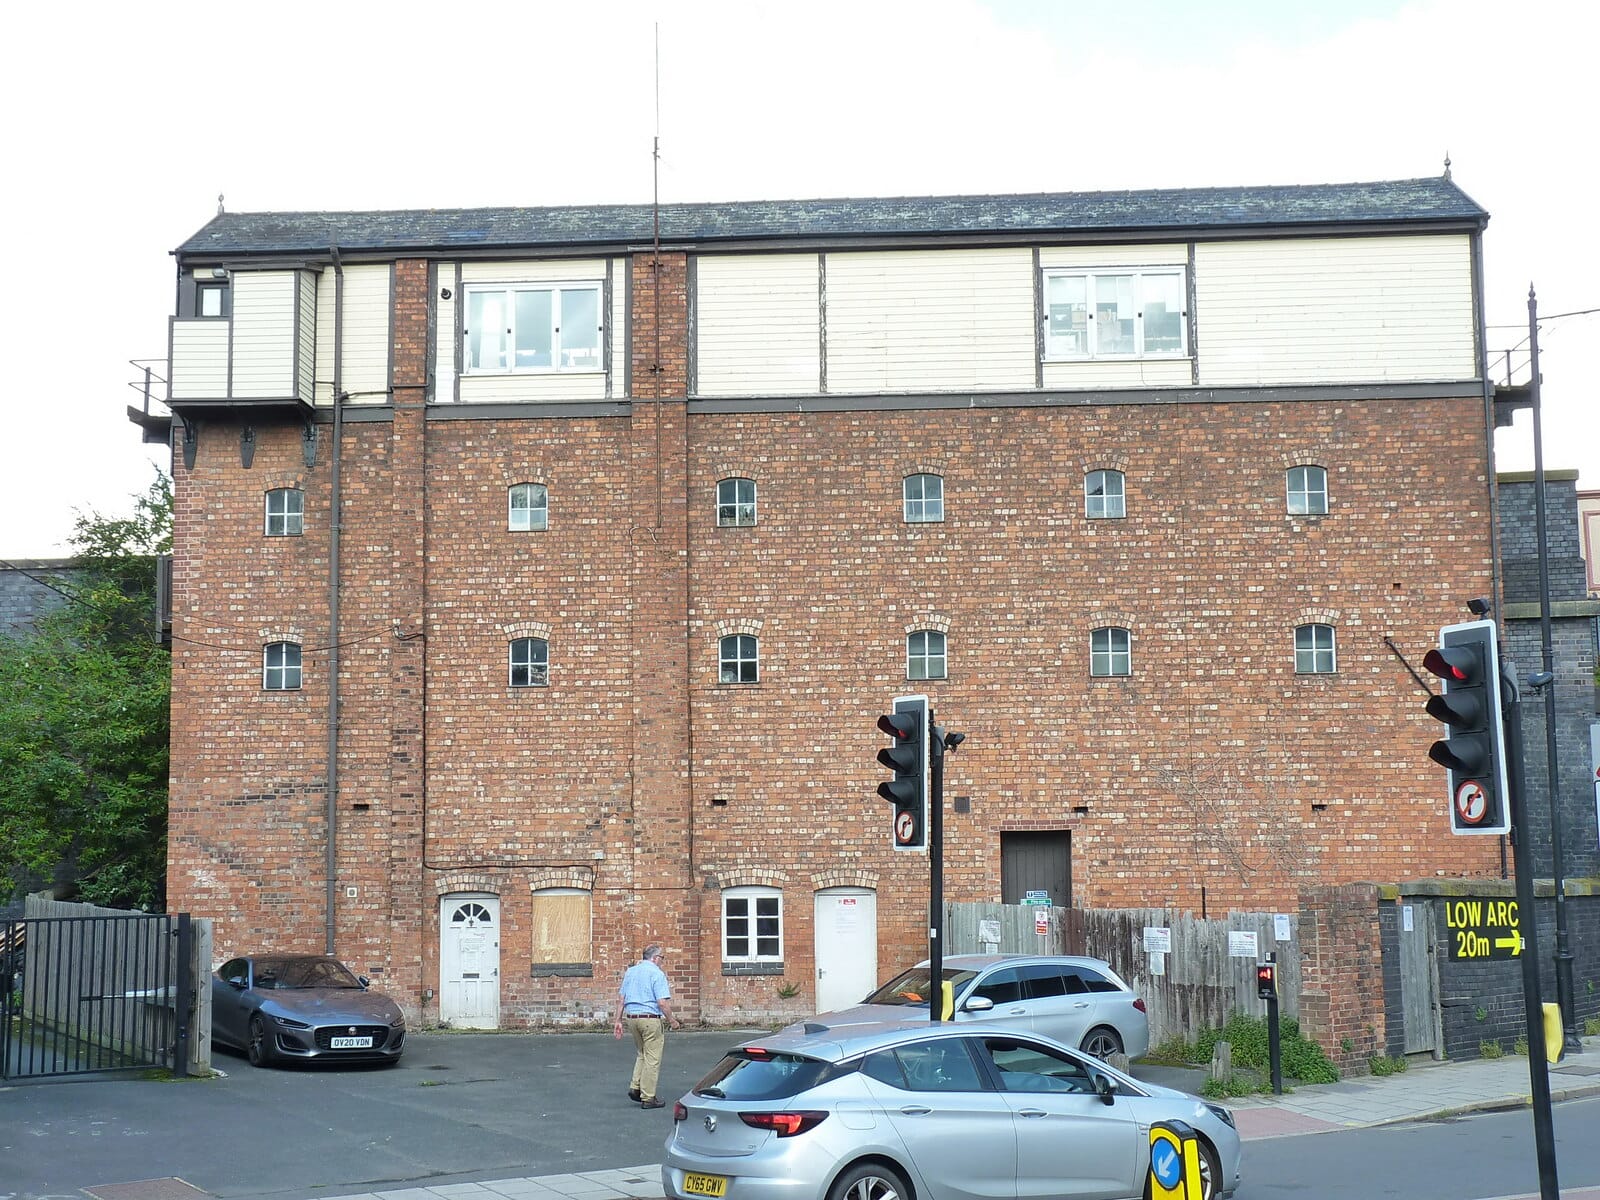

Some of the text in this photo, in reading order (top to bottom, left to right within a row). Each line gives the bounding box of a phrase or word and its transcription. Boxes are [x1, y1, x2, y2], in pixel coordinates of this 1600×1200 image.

[1446, 901, 1519, 928] LOW ARC
[1457, 931, 1490, 957] 20m
[334, 1037, 370, 1047] OV20 VDN
[686, 1175, 723, 1194] CY65 GWV
